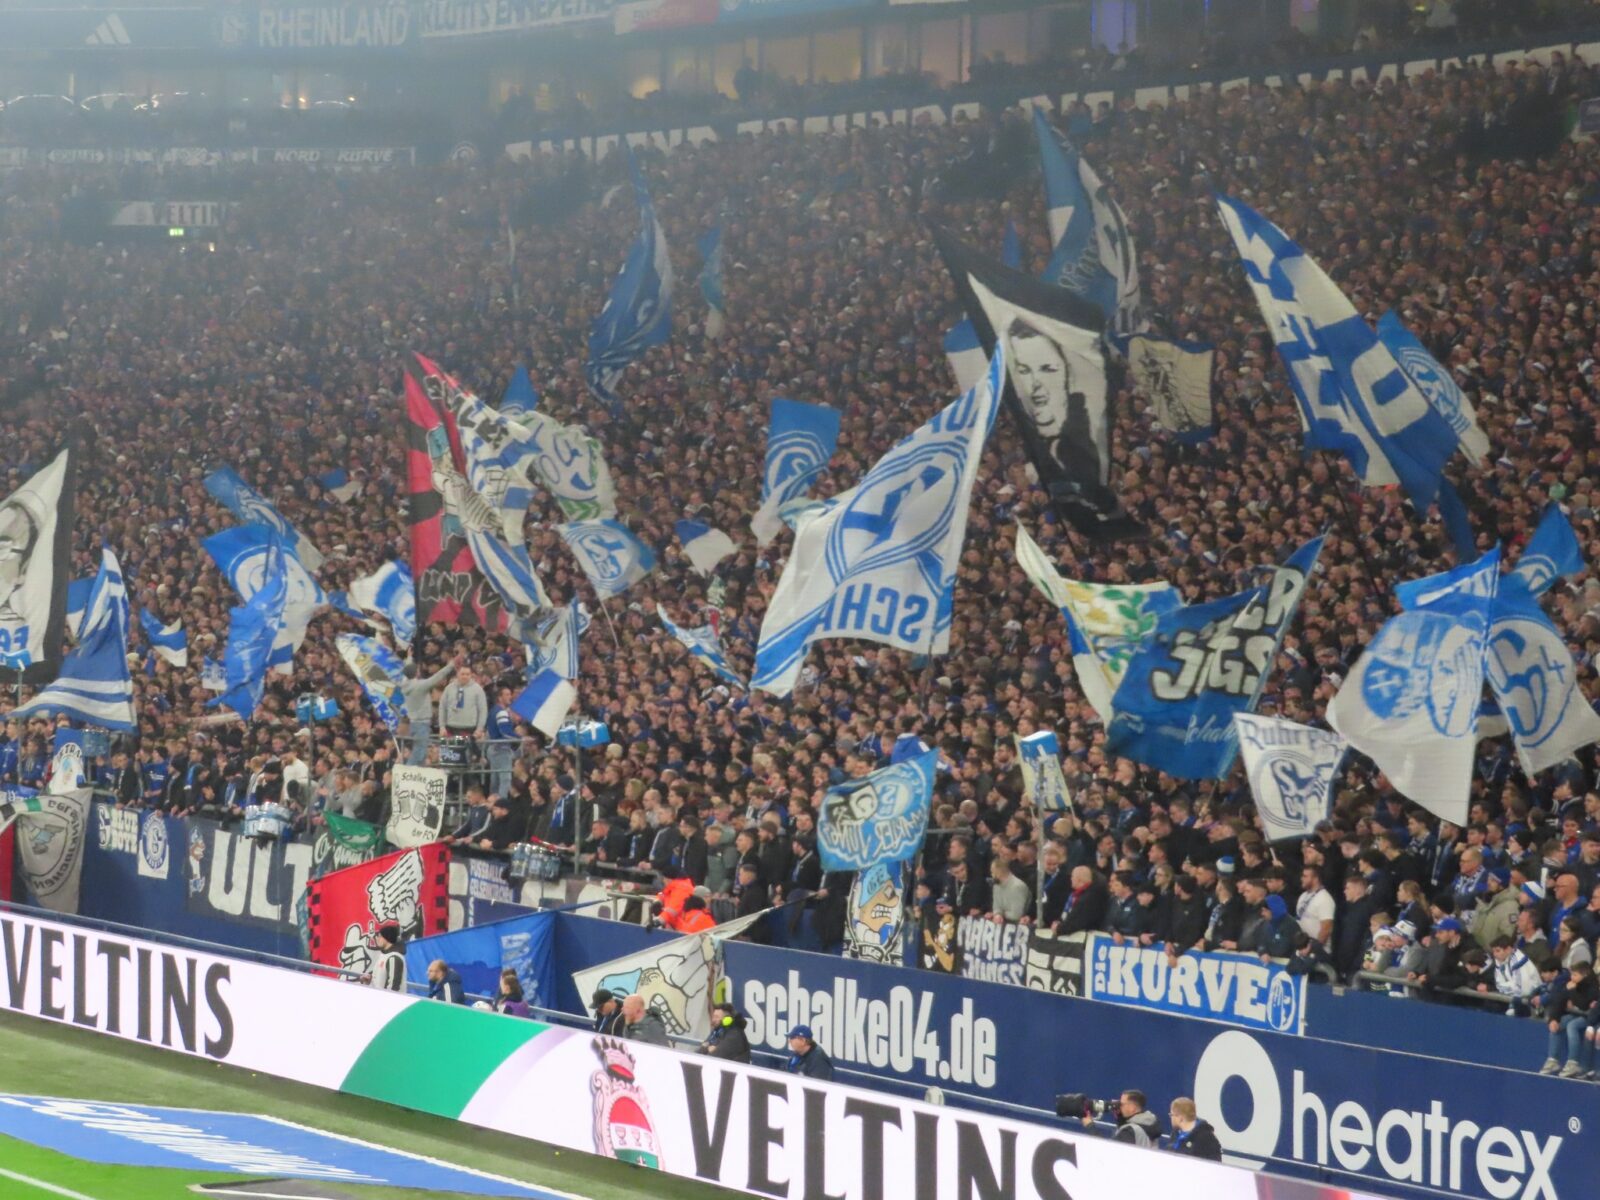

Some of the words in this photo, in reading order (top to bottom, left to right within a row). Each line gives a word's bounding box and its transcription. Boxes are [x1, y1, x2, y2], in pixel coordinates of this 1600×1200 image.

[259, 7, 410, 47] RHEINLAND
[273, 149, 320, 162] NORD
[1, 918, 235, 1060] VELTINS
[957, 917, 1030, 966] MARLER
[1107, 946, 1270, 1023] KURVE
[744, 969, 997, 1089] schalke04.de
[680, 1060, 1078, 1200] VELTINS
[1293, 1069, 1563, 1200] heatrex
